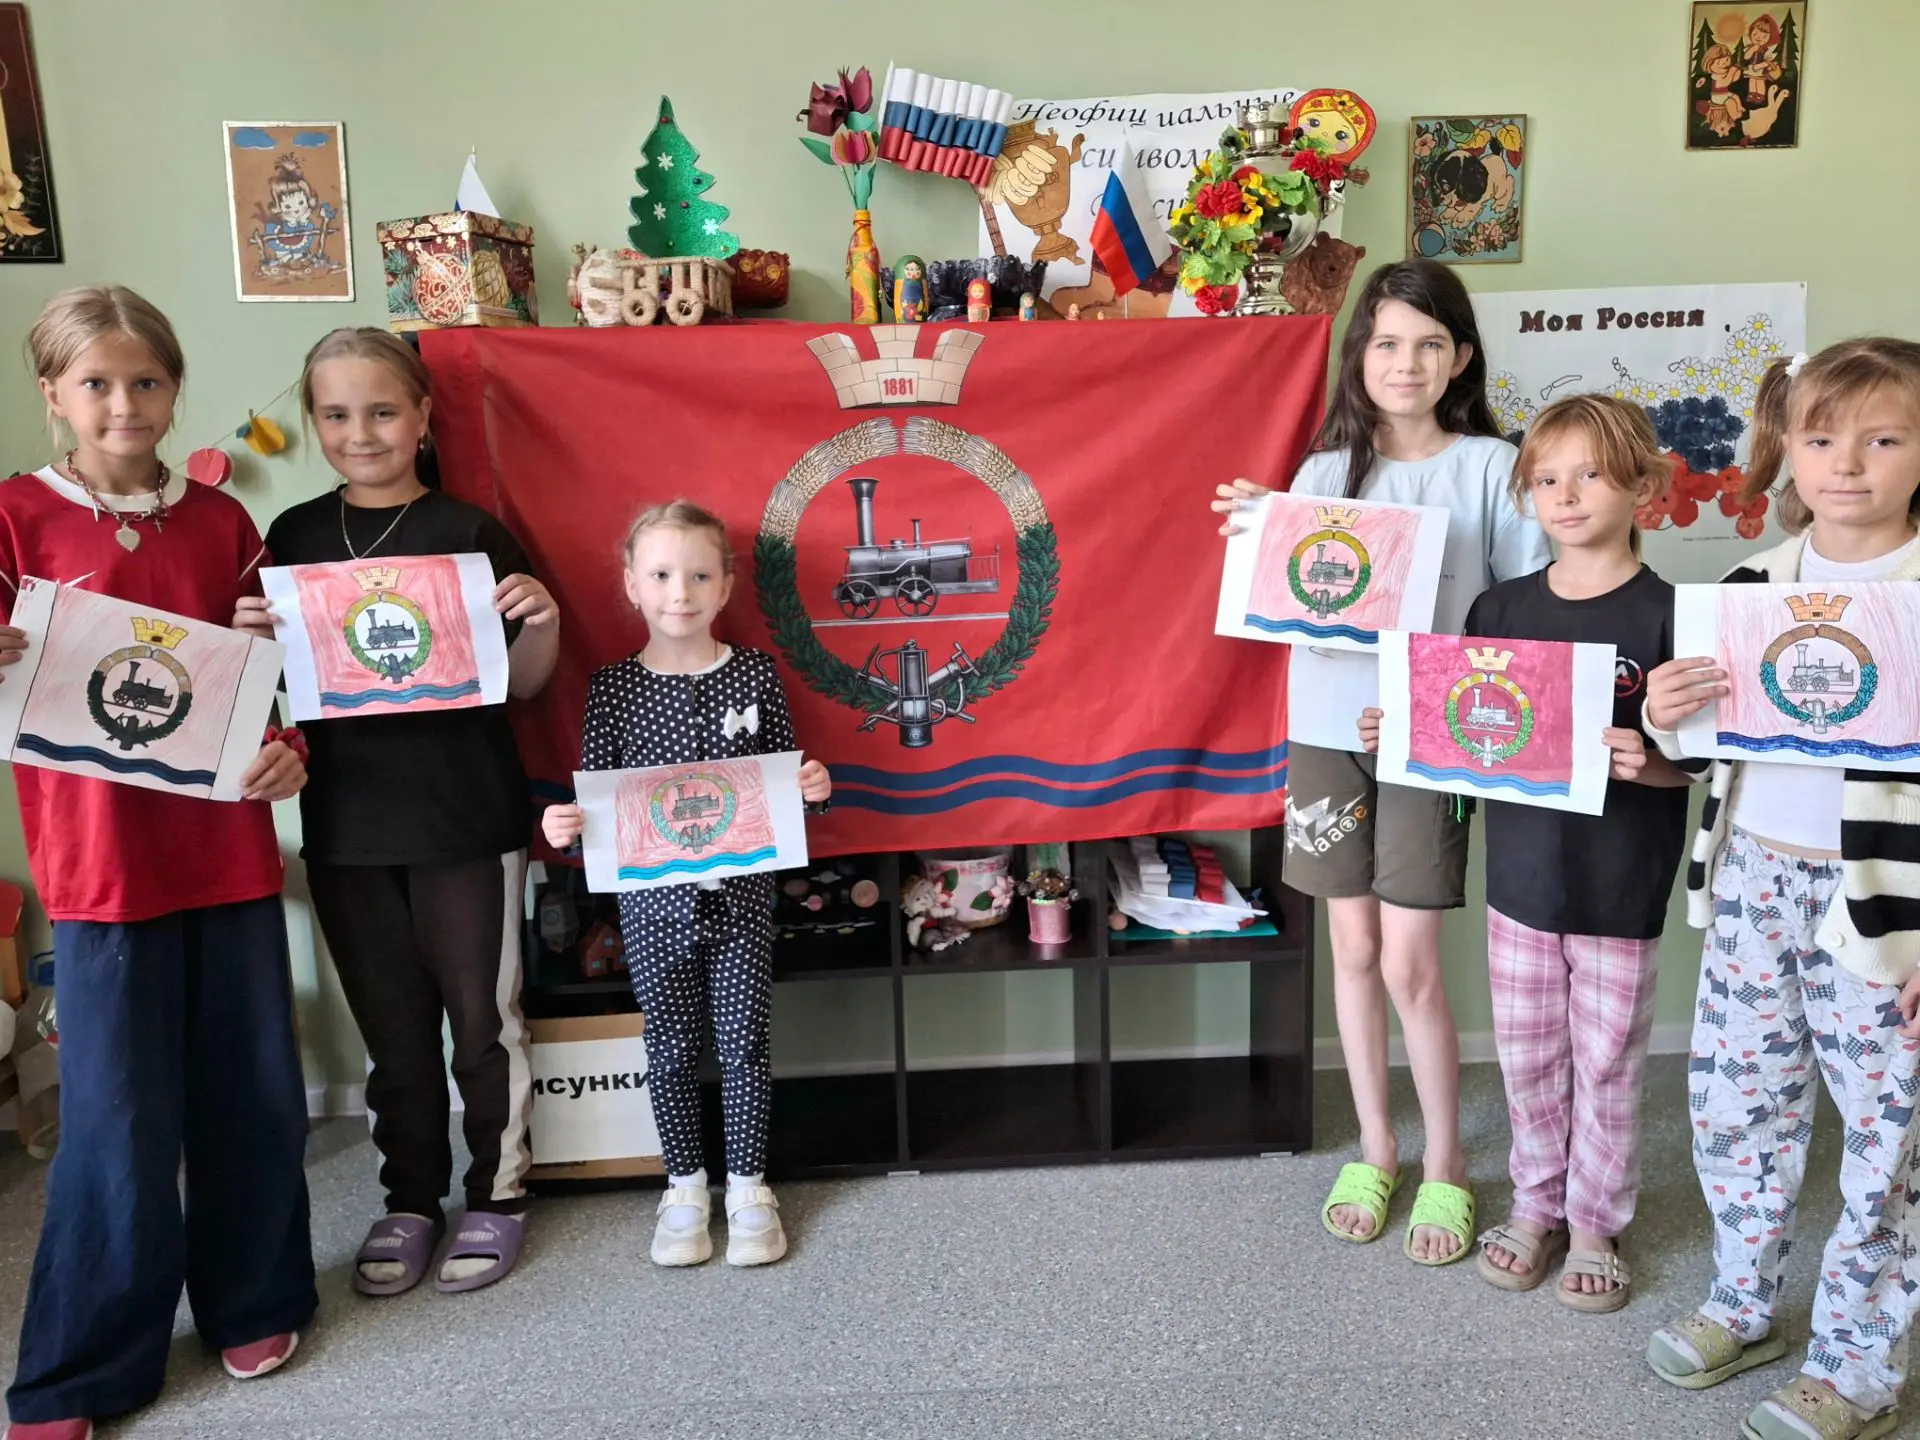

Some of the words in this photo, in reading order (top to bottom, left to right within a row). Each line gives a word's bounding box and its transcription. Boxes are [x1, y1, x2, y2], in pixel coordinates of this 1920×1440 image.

[1081, 148, 1211, 169] сивол
[1519, 309, 1583, 333] Моя
[1597, 306, 1705, 330] Россия
[883, 378, 913, 396] 1881
[533, 1072, 651, 1099] исунки
